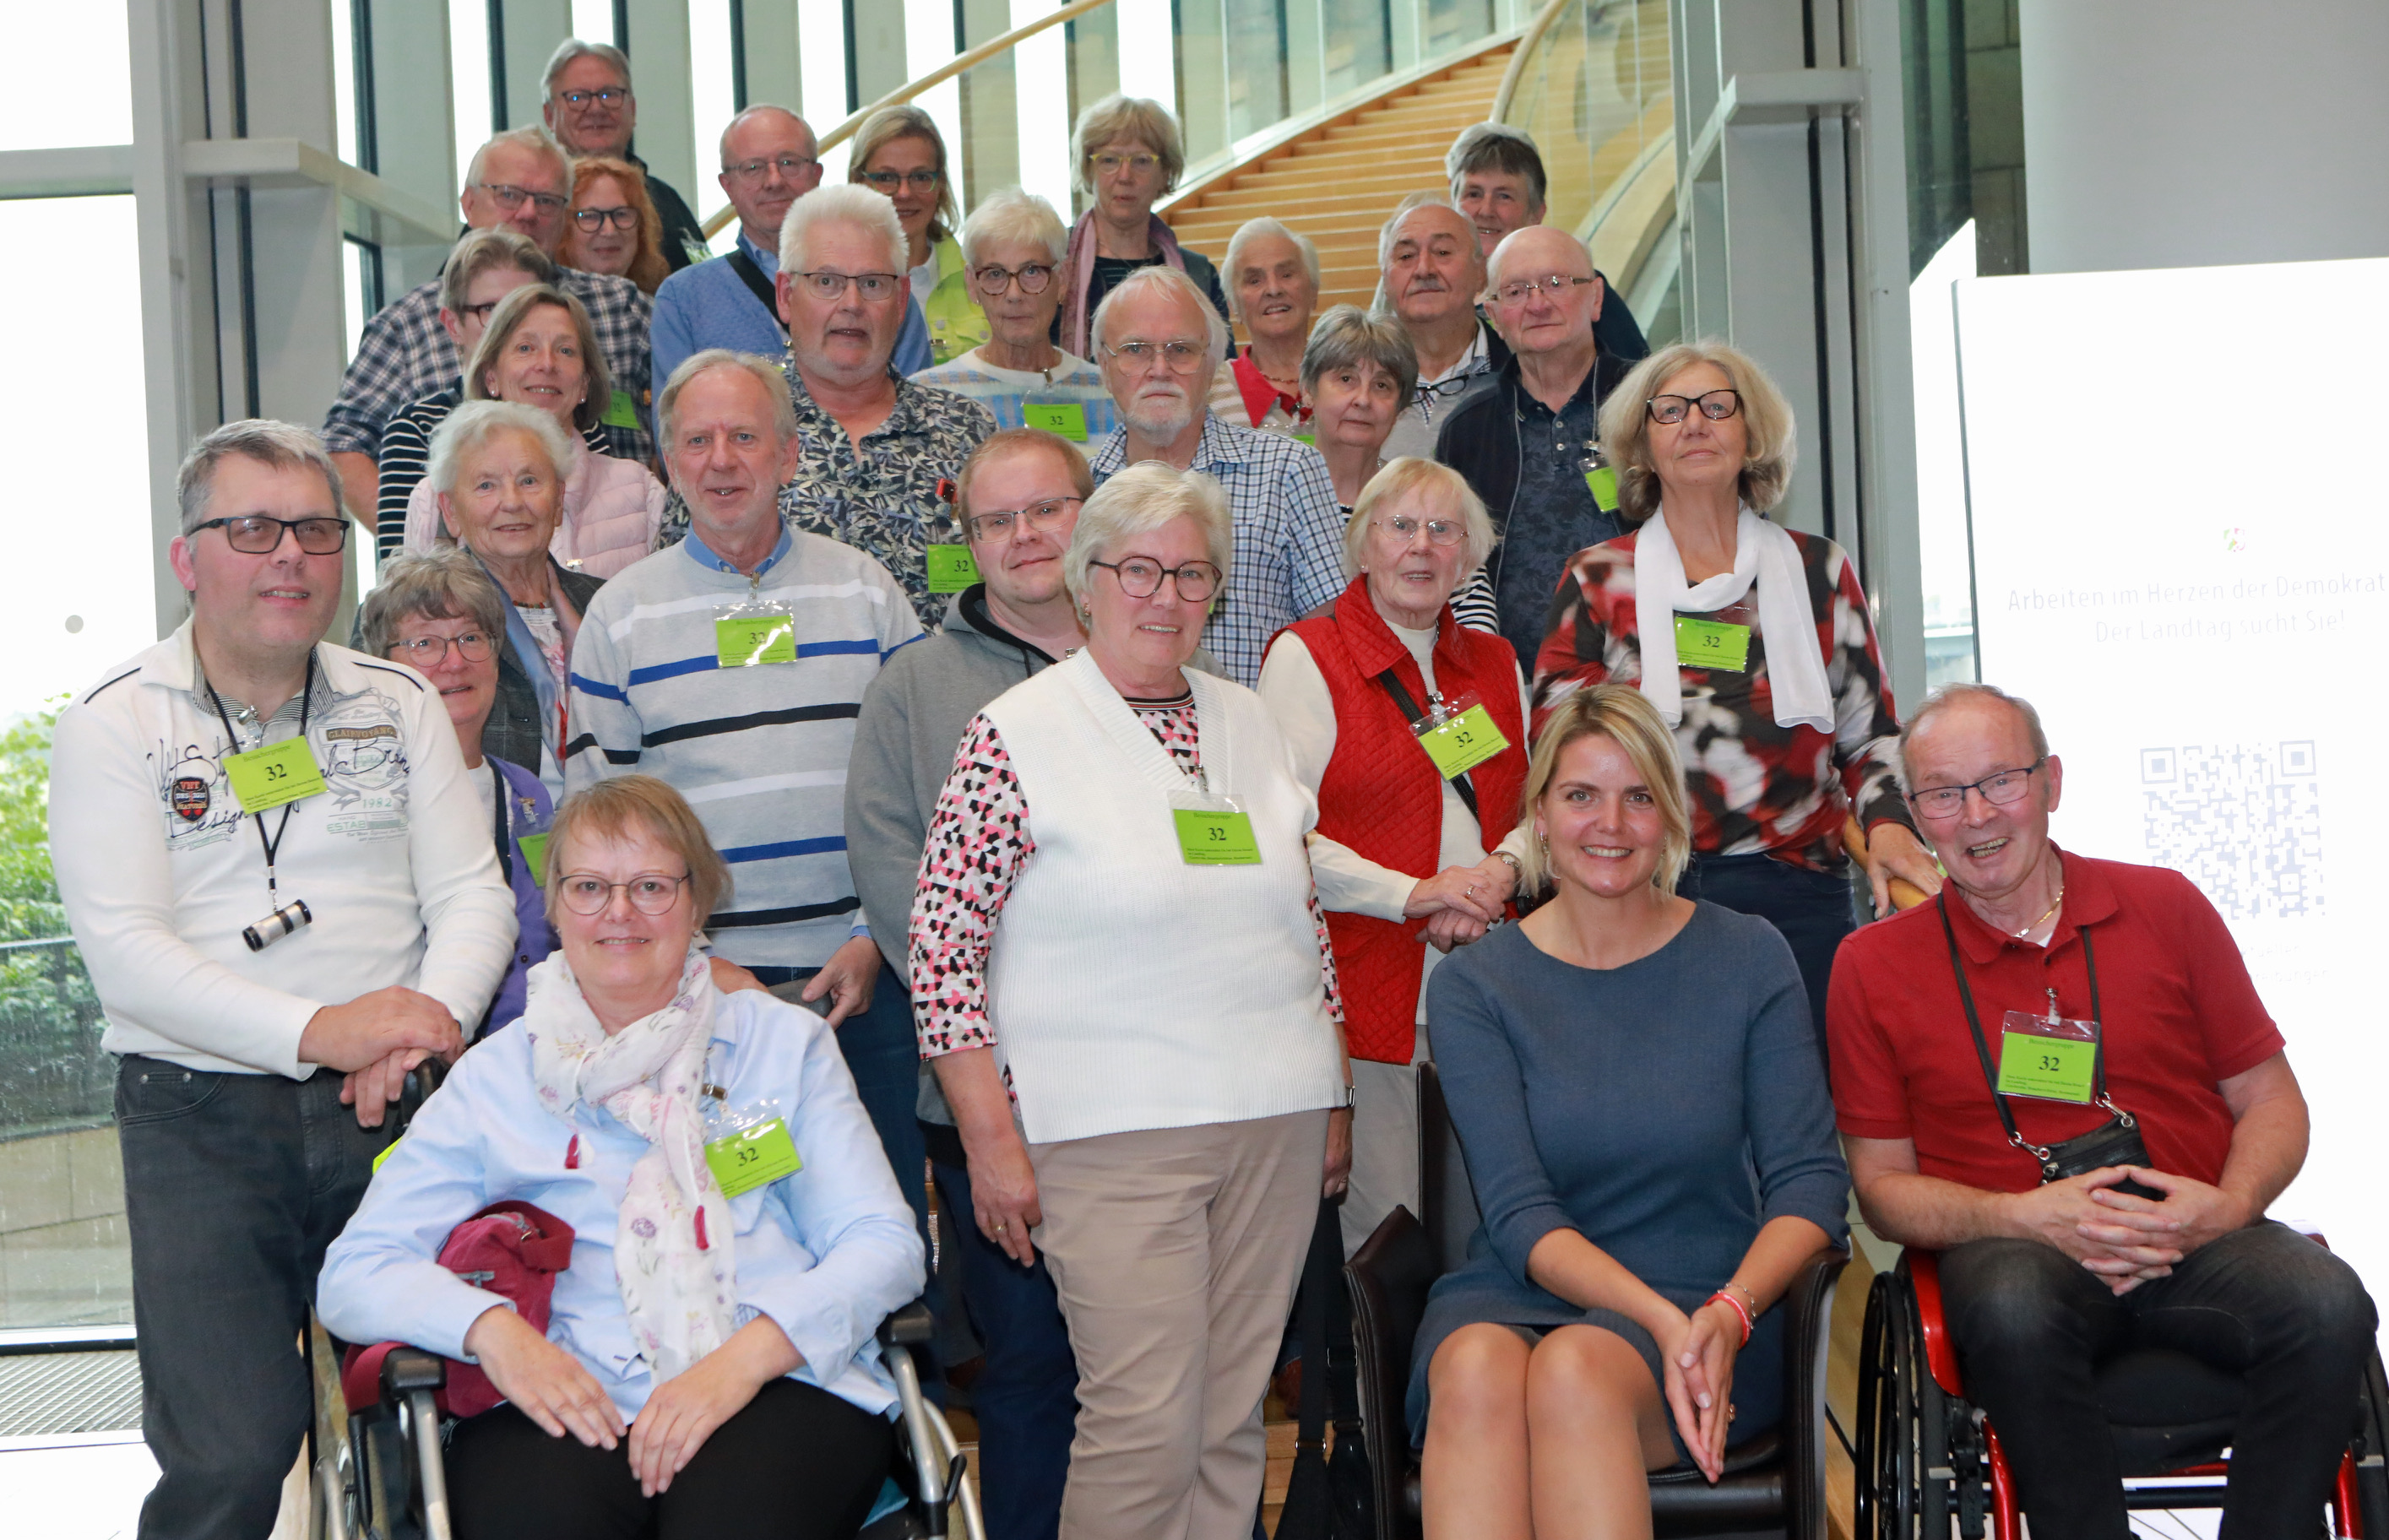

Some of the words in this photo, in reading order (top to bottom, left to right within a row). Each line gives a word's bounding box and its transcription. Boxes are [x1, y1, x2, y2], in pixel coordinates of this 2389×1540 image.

[1050, 415, 1064, 426] 32
[954, 560, 969, 572] 32
[2007, 587, 2104, 612] Arbeiten
[2111, 587, 2140, 606] im
[2147, 581, 2224, 604] Herzen
[2232, 577, 2268, 599] der
[2276, 572, 2386, 598] Demokrat
[2096, 620, 2133, 643] Der
[2140, 615, 2233, 642] Landtag
[2239, 612, 2298, 636] sucht
[2306, 609, 2346, 632] Sie!
[749, 632, 766, 644] 32
[1702, 635, 1720, 648] 32
[1454, 731, 1474, 748] 32
[264, 763, 287, 781] 32
[362, 797, 393, 808] 1982
[1208, 827, 1226, 841] 32
[2039, 1055, 2060, 1071] 32
[736, 1147, 760, 1167] 32
